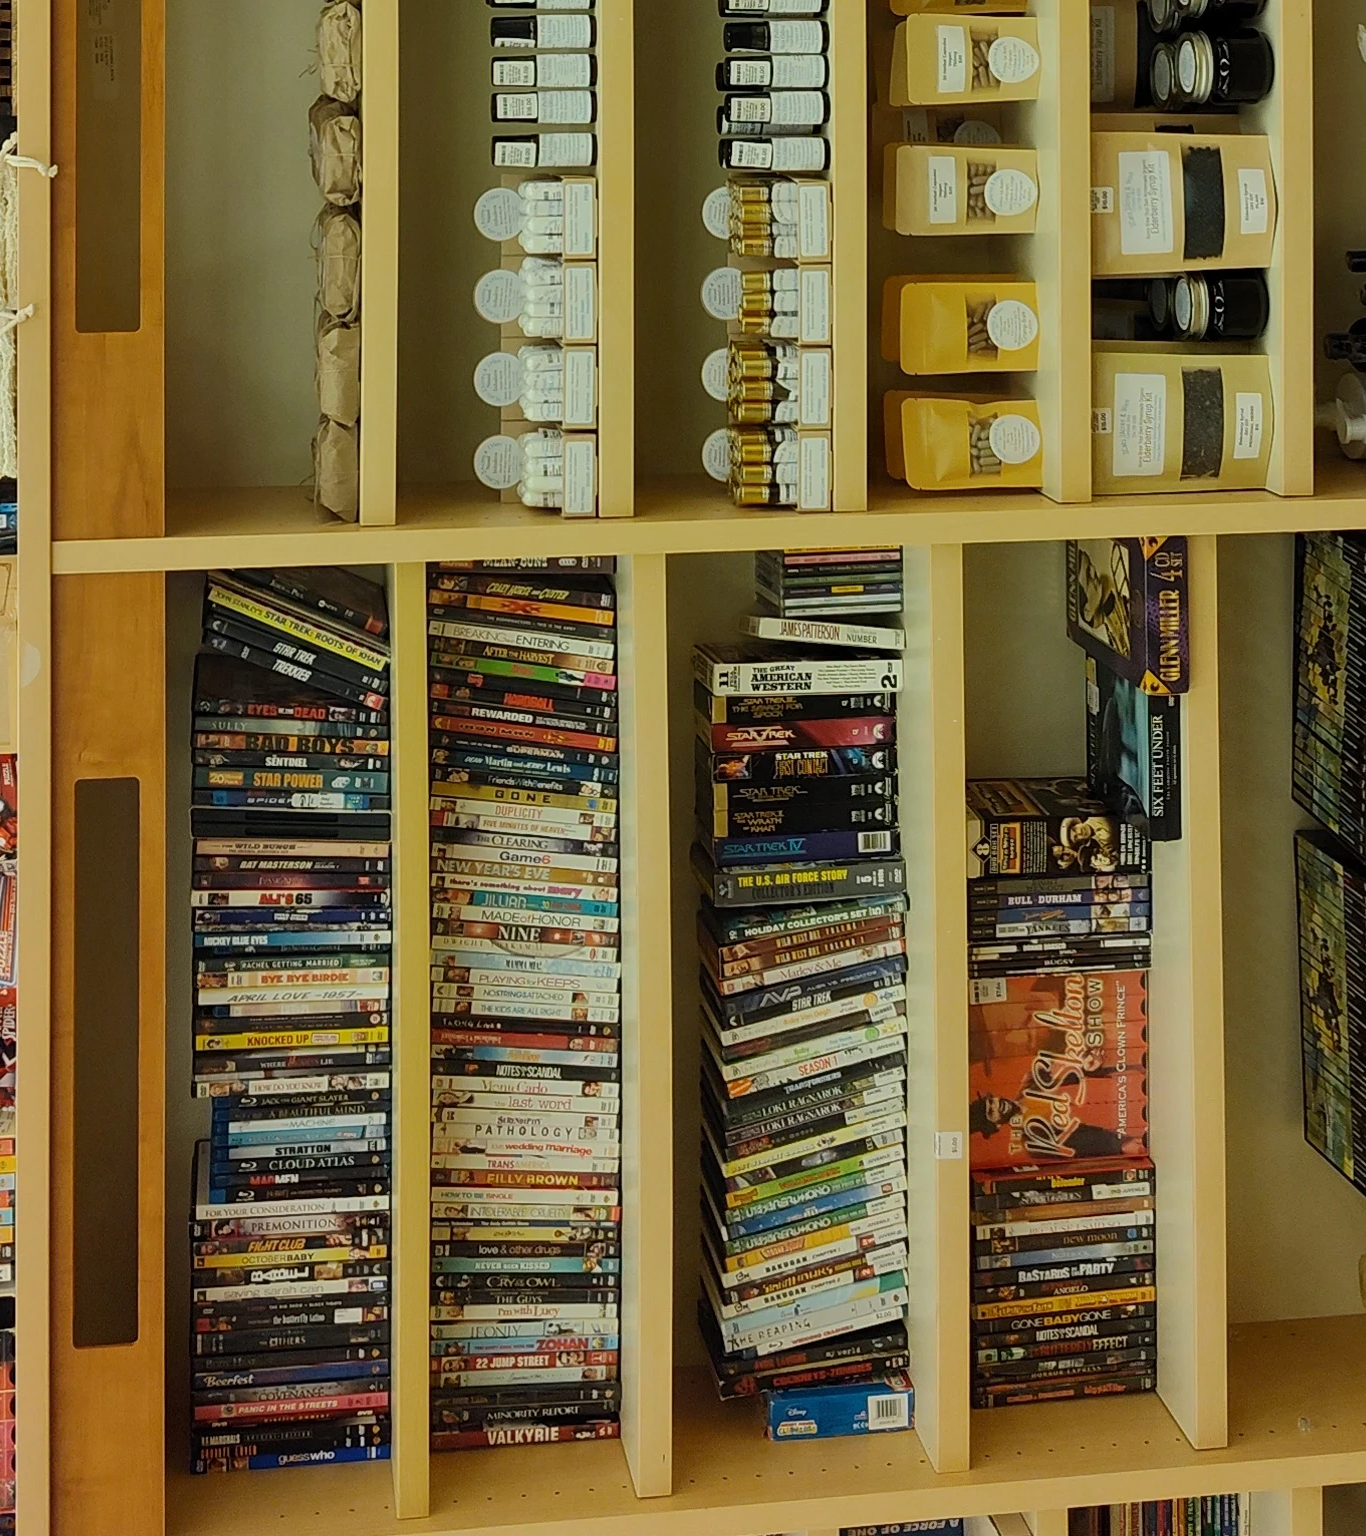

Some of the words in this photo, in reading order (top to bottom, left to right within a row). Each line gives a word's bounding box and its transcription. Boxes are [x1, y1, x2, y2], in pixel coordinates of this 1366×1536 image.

[1143, 392, 1153, 403] Kit
[1143, 405, 1154, 424] Syrup
[1143, 425, 1153, 463] Elderberry
[1154, 552, 1169, 567] CD
[1170, 552, 1183, 567] SET
[1150, 569, 1183, 581] 4
[1159, 590, 1180, 637] MILLER
[264, 611, 287, 626] STAR
[288, 619, 313, 637] TREK:
[315, 632, 343, 649] ROOTS
[346, 645, 357, 654] OF
[359, 650, 381, 665] KHAN
[780, 621, 801, 636] JAMES
[802, 622, 840, 640] PATTERSON
[453, 627, 507, 640] BREAKING
[516, 635, 570, 651] ENTERING
[846, 634, 877, 644] NUMBER
[1160, 640, 1181, 681] GLENN
[272, 659, 312, 682] TREKKIES
[751, 673, 812, 682] AMERICAN
[752, 682, 812, 691] WESTERN
[247, 698, 278, 716] EYES
[294, 704, 326, 719] DEAD
[472, 708, 533, 723] REWARDED
[1151, 714, 1164, 758] UNDER
[246, 736, 290, 751] BAD
[297, 738, 355, 753] BOYS
[775, 752, 801, 760] STAR
[803, 751, 828, 759] TREK
[253, 773, 280, 786] STAR
[284, 775, 323, 788] POWER
[1151, 760, 1164, 792] FEET
[495, 790, 550, 803] GONE
[495, 806, 543, 819] DUPLICITY
[1151, 793, 1164, 817] SIX
[492, 836, 548, 849] CLEARING
[240, 860, 257, 868] BAT
[258, 861, 313, 870] MASTERSON
[437, 860, 474, 874] NEW
[475, 863, 521, 878] YEAR'S
[524, 868, 550, 881] EVE
[738, 876, 753, 887] THE
[756, 875, 773, 886] U.S.
[776, 874, 789, 884] AIR
[792, 872, 818, 883] FORCE
[821, 869, 847, 881] STORY
[259, 893, 293, 904] ALI'S
[295, 893, 312, 904] 65
[1008, 896, 1032, 905] BULL
[1038, 894, 1082, 904] DURHAM
[744, 923, 785, 937] HOLIDAY
[787, 913, 849, 929] COLLECTOR'S
[851, 910, 867, 918] SET
[498, 926, 540, 942] NINE
[261, 975, 283, 983] BYE
[287, 974, 309, 983] BYE
[312, 973, 348, 982] BIRDIE
[479, 975, 523, 985] PLAYING
[537, 977, 580, 989] KEEPS
[759, 986, 802, 1007] AVP
[792, 996, 813, 1011] STAR
[814, 991, 831, 1006] TREK
[1087, 977, 1104, 1047] SHOW
[247, 1036, 293, 1046] KNOCKED
[296, 1034, 309, 1044] UP
[1034, 973, 1086, 1105] Skelton
[1116, 1031, 1126, 1072] CLOWN
[784, 1073, 841, 1094] TRANSFORMERS
[508, 1096, 534, 1108] last
[538, 1098, 572, 1110] word
[762, 1104, 786, 1116] LOKI
[789, 1086, 842, 1109] RAGNAROK
[761, 1120, 785, 1133] LOKI
[788, 1104, 841, 1126] RAGNAROK
[1023, 1088, 1081, 1158] Red
[475, 1125, 573, 1140] PATHOLOGY
[1009, 1116, 1022, 1156] THE
[275, 1145, 331, 1156] STRATTON
[505, 1142, 543, 1151] wedding
[546, 1143, 592, 1157] marriage
[269, 1158, 315, 1171] CLOUD
[318, 1156, 355, 1167] ATLAS
[487, 1174, 523, 1184] FILLY
[527, 1175, 579, 1185] BROWN
[206, 1209, 221, 1218] FOR
[224, 1208, 247, 1216] YOUR
[250, 1203, 324, 1214] CONSIDERATION
[251, 1219, 337, 1232] PREMONITION
[248, 1240, 277, 1252] FIGHT
[278, 1239, 306, 1250] CLUB
[479, 1245, 498, 1254] love
[501, 1246, 507, 1254] &
[509, 1245, 532, 1254] other
[534, 1246, 561, 1257] drugs
[1053, 1285, 1089, 1295] ANGELO
[728, 1335, 753, 1347] THE
[758, 1319, 810, 1340] REAPING
[536, 1338, 588, 1351] ZOHAN
[1093, 1336, 1128, 1350] EFFECT
[476, 1358, 487, 1368] 22
[490, 1357, 515, 1368] JUMP
[517, 1355, 550, 1367] STREET
[204, 1375, 255, 1387] Beerfest
[239, 1404, 265, 1414] PANIC
[267, 1403, 276, 1412] IN
[279, 1402, 297, 1411] THE
[298, 1400, 338, 1410] STREETS
[487, 1409, 539, 1420] MINORITY
[542, 1406, 580, 1417] REPORT
[488, 1427, 559, 1445] VALKYRIE
